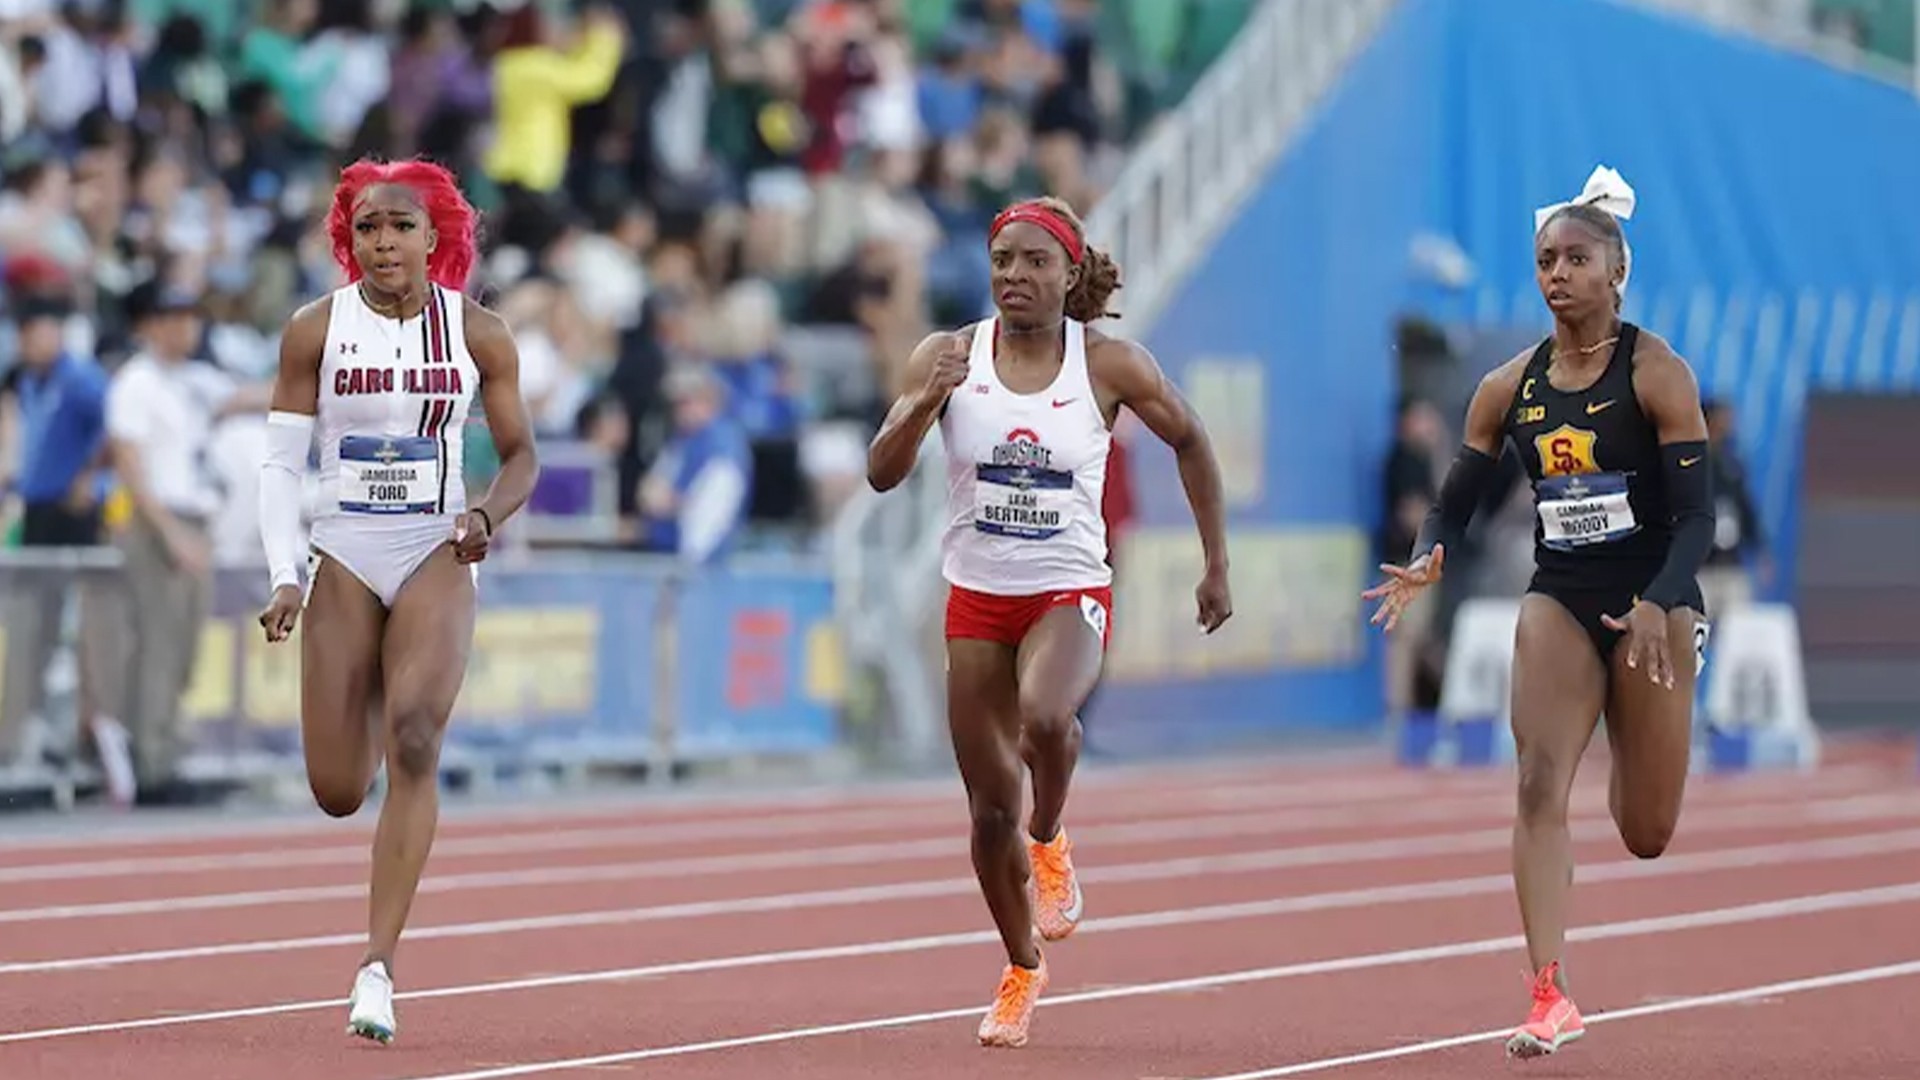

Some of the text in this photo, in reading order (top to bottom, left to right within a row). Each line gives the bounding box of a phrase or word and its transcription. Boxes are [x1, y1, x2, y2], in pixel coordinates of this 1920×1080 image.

[334, 367, 463, 396] CAROLINA
[1523, 379, 1536, 399] C
[368, 484, 408, 500] FORD
[984, 505, 1060, 526] BERTRAND
[1560, 514, 1609, 535] MOODY
